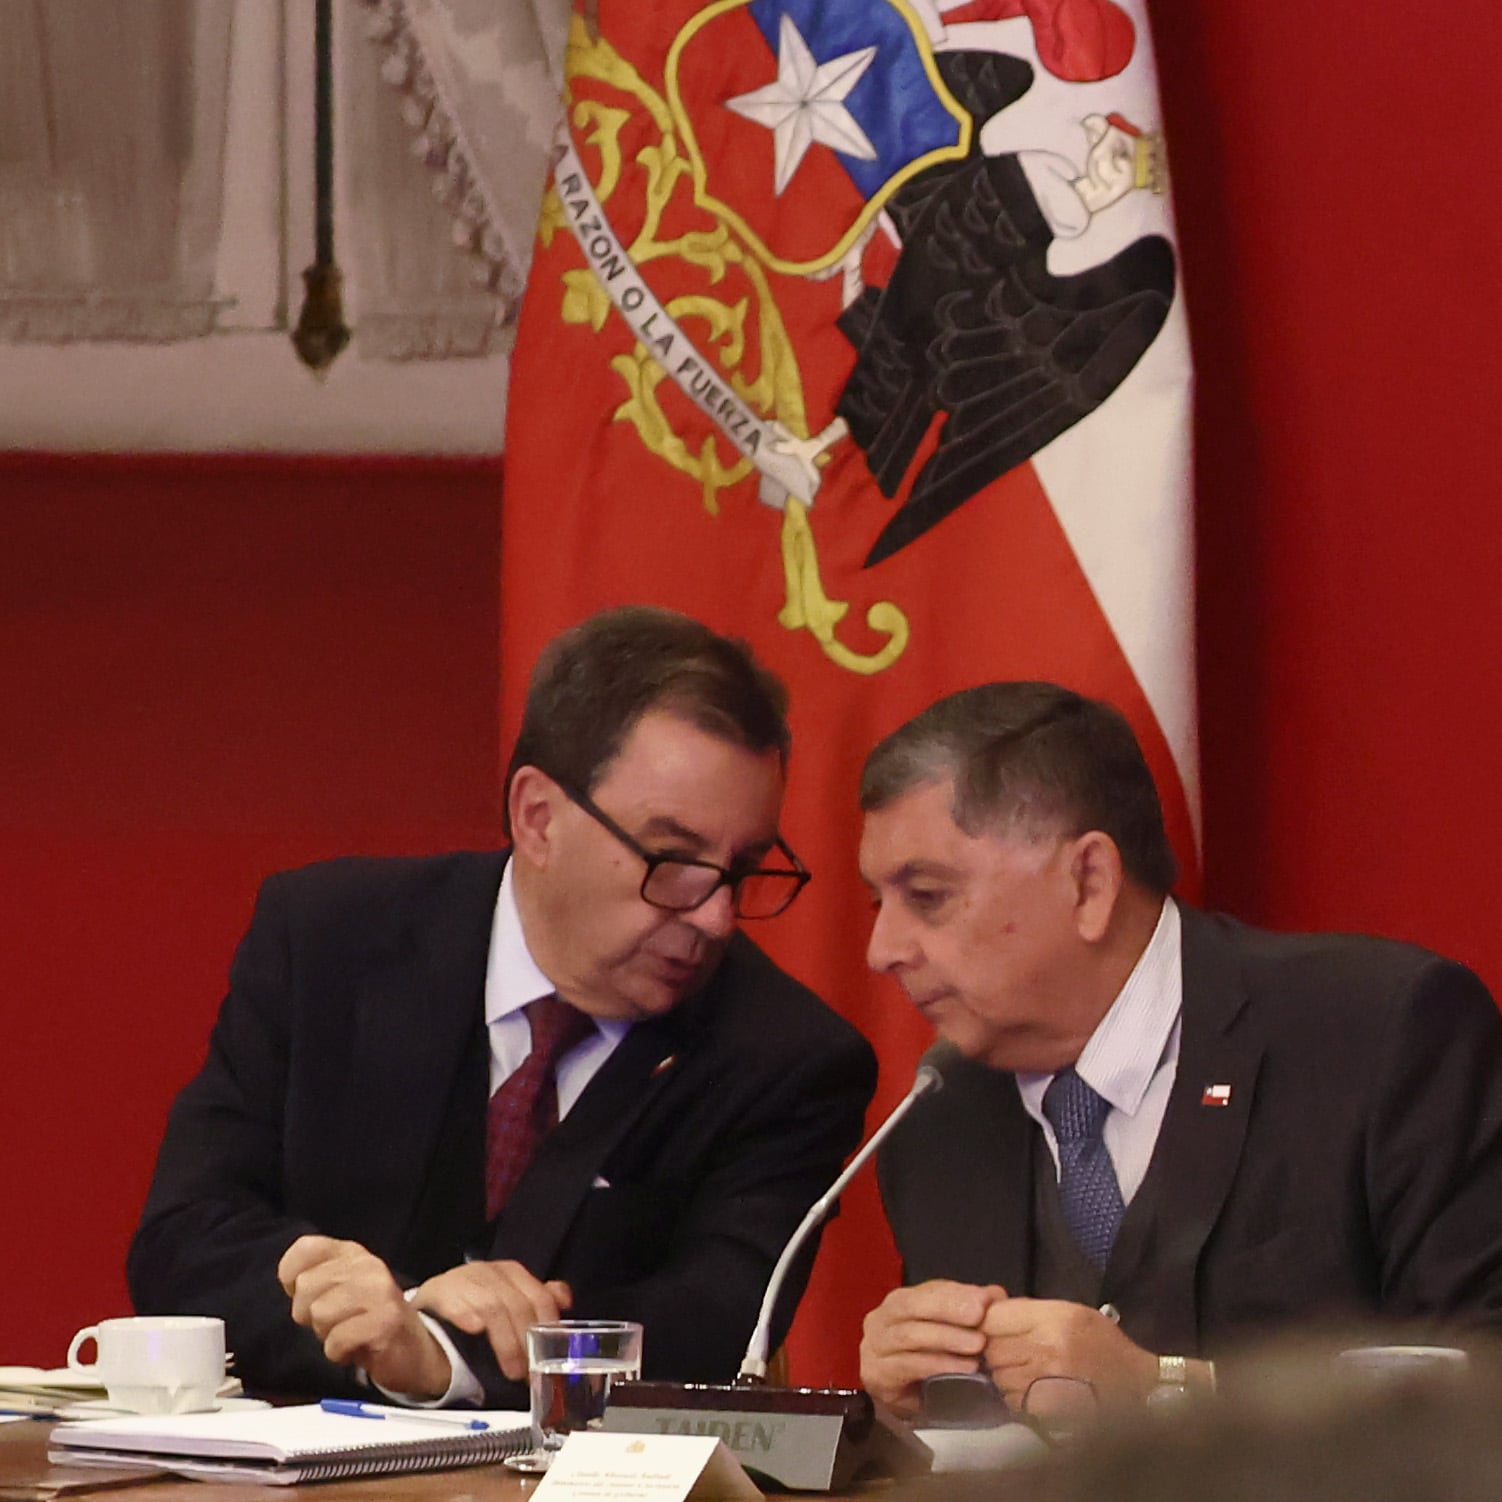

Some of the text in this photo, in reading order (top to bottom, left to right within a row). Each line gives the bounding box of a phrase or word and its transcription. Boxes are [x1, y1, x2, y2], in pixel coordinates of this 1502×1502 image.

[560, 173, 626, 281] RAZON
[621, 287, 644, 311] O
[639, 313, 674, 356] LA
[676, 358, 763, 456] FUERZA
